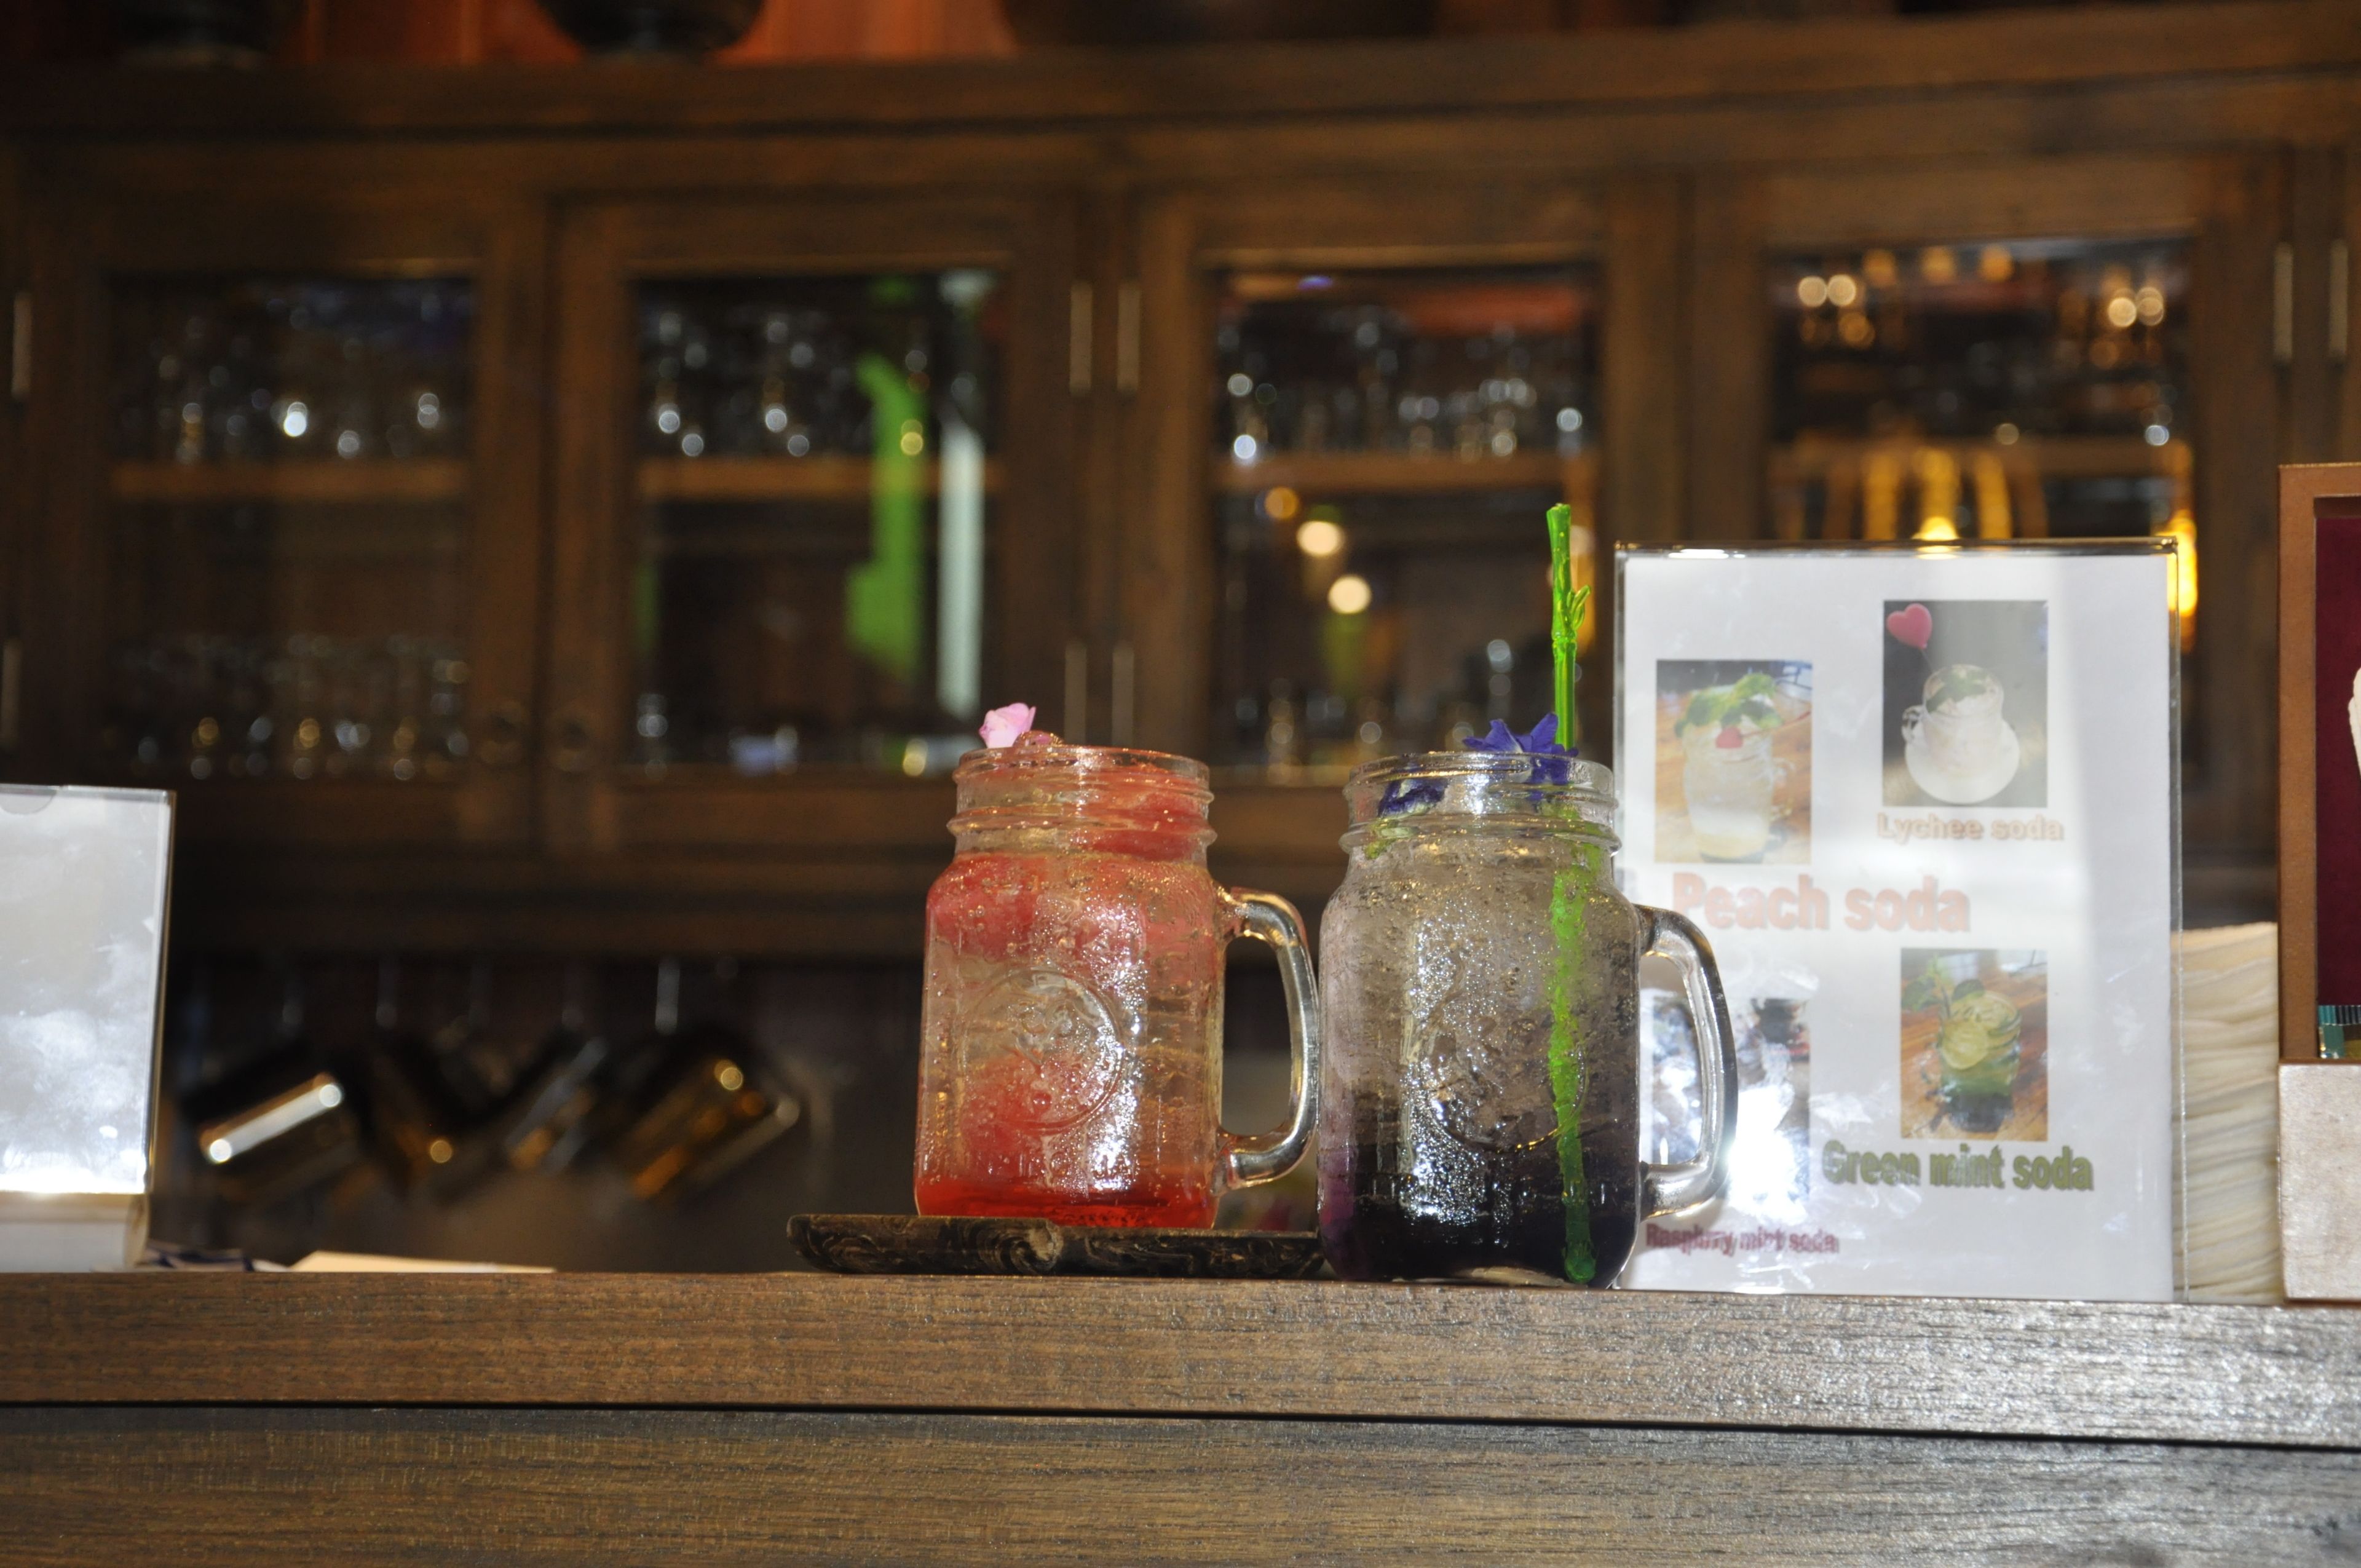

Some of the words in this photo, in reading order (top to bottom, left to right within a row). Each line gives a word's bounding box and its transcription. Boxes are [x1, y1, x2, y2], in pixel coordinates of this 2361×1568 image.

[1877, 813, 1983, 844] Lychee
[1991, 815, 2064, 841] soda
[1672, 872, 1829, 930] Peach
[1845, 875, 1971, 933] soda
[1822, 1140, 1921, 1187] Green
[1929, 1144, 2006, 1189] mint
[2013, 1146, 2094, 1191] soda
[1789, 1229, 1840, 1254] soda
